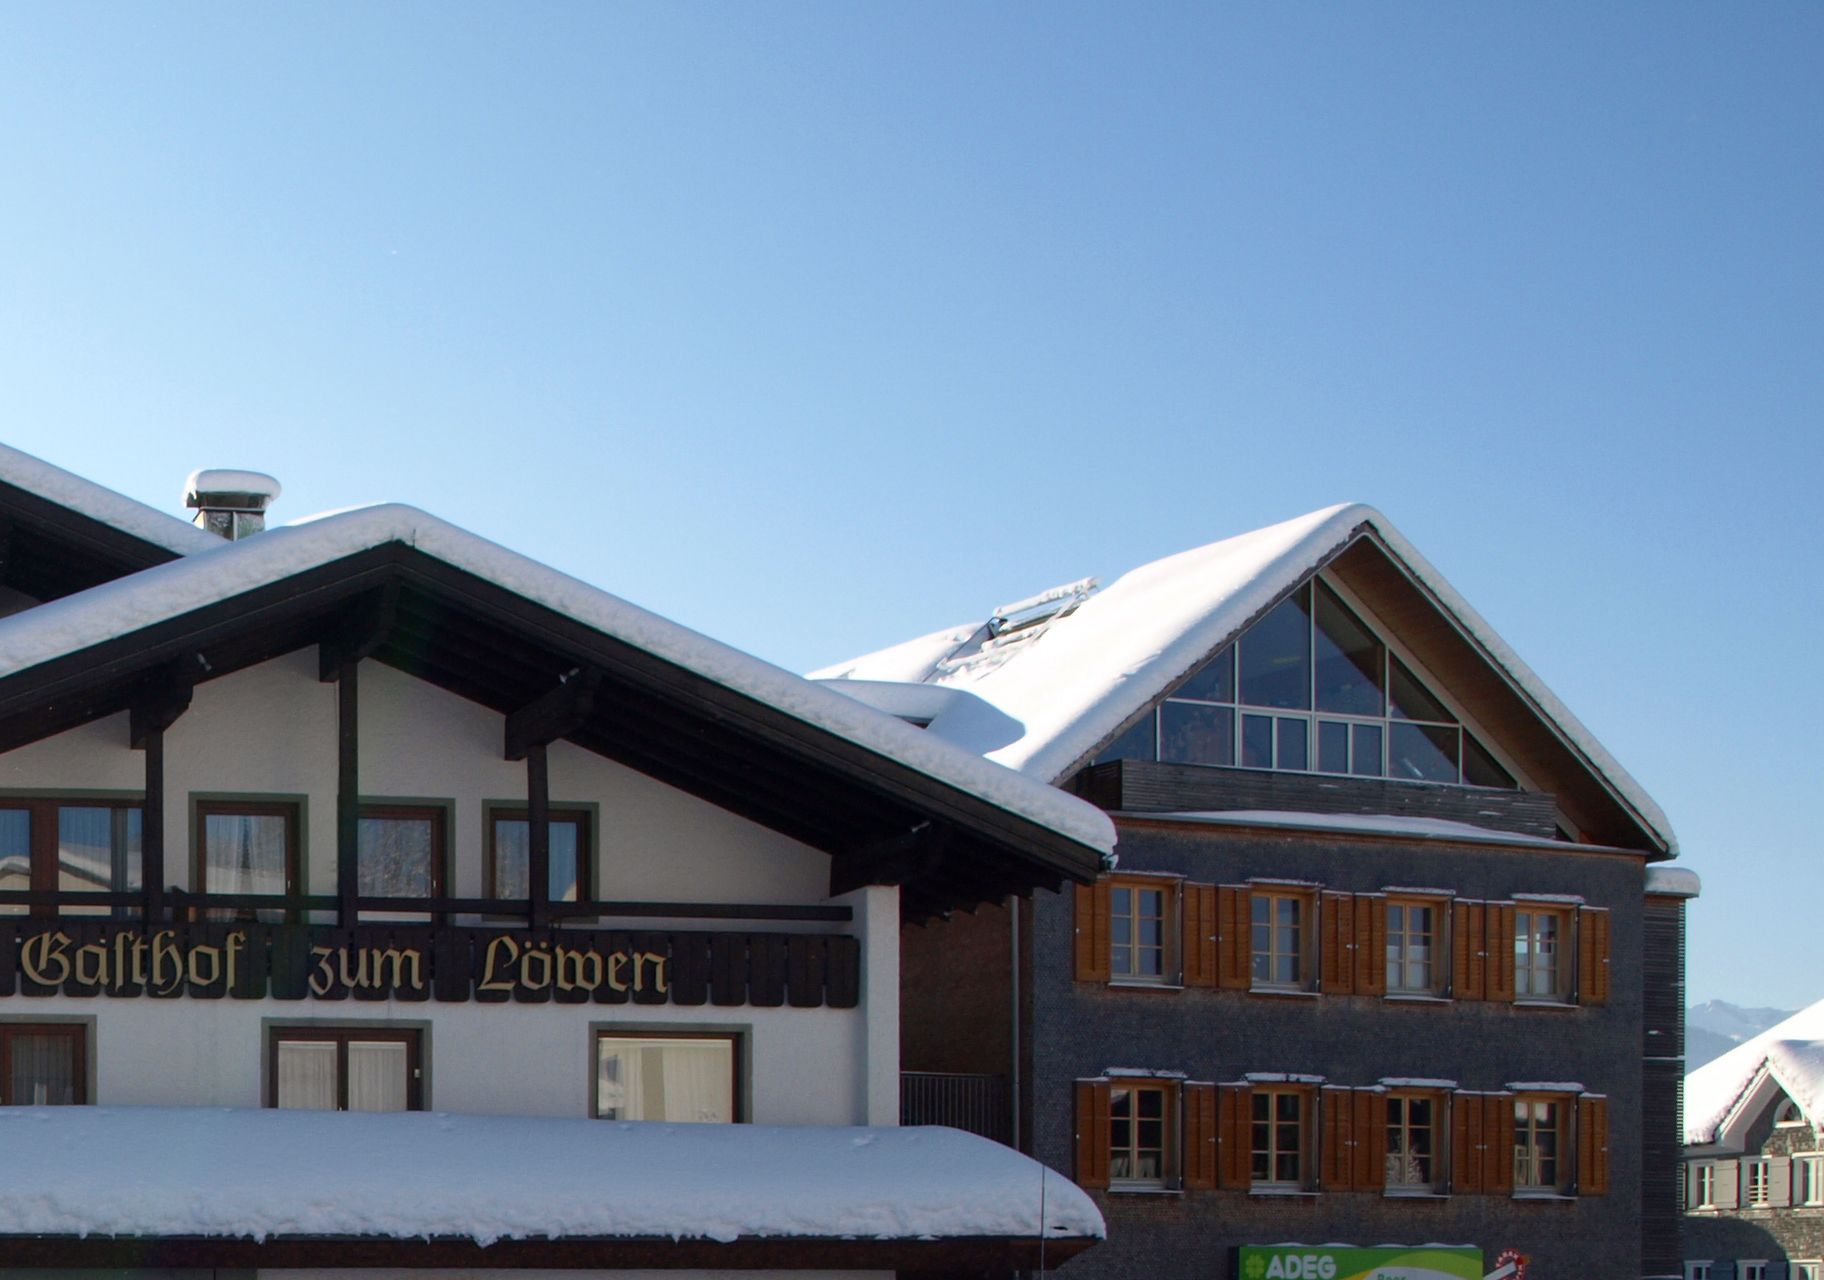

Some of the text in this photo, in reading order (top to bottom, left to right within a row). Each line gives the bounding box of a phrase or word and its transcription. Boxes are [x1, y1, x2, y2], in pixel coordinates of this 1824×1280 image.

[308, 940, 424, 997] zum
[478, 933, 668, 993] Löwen
[1265, 1253, 1337, 1280] ADEG
